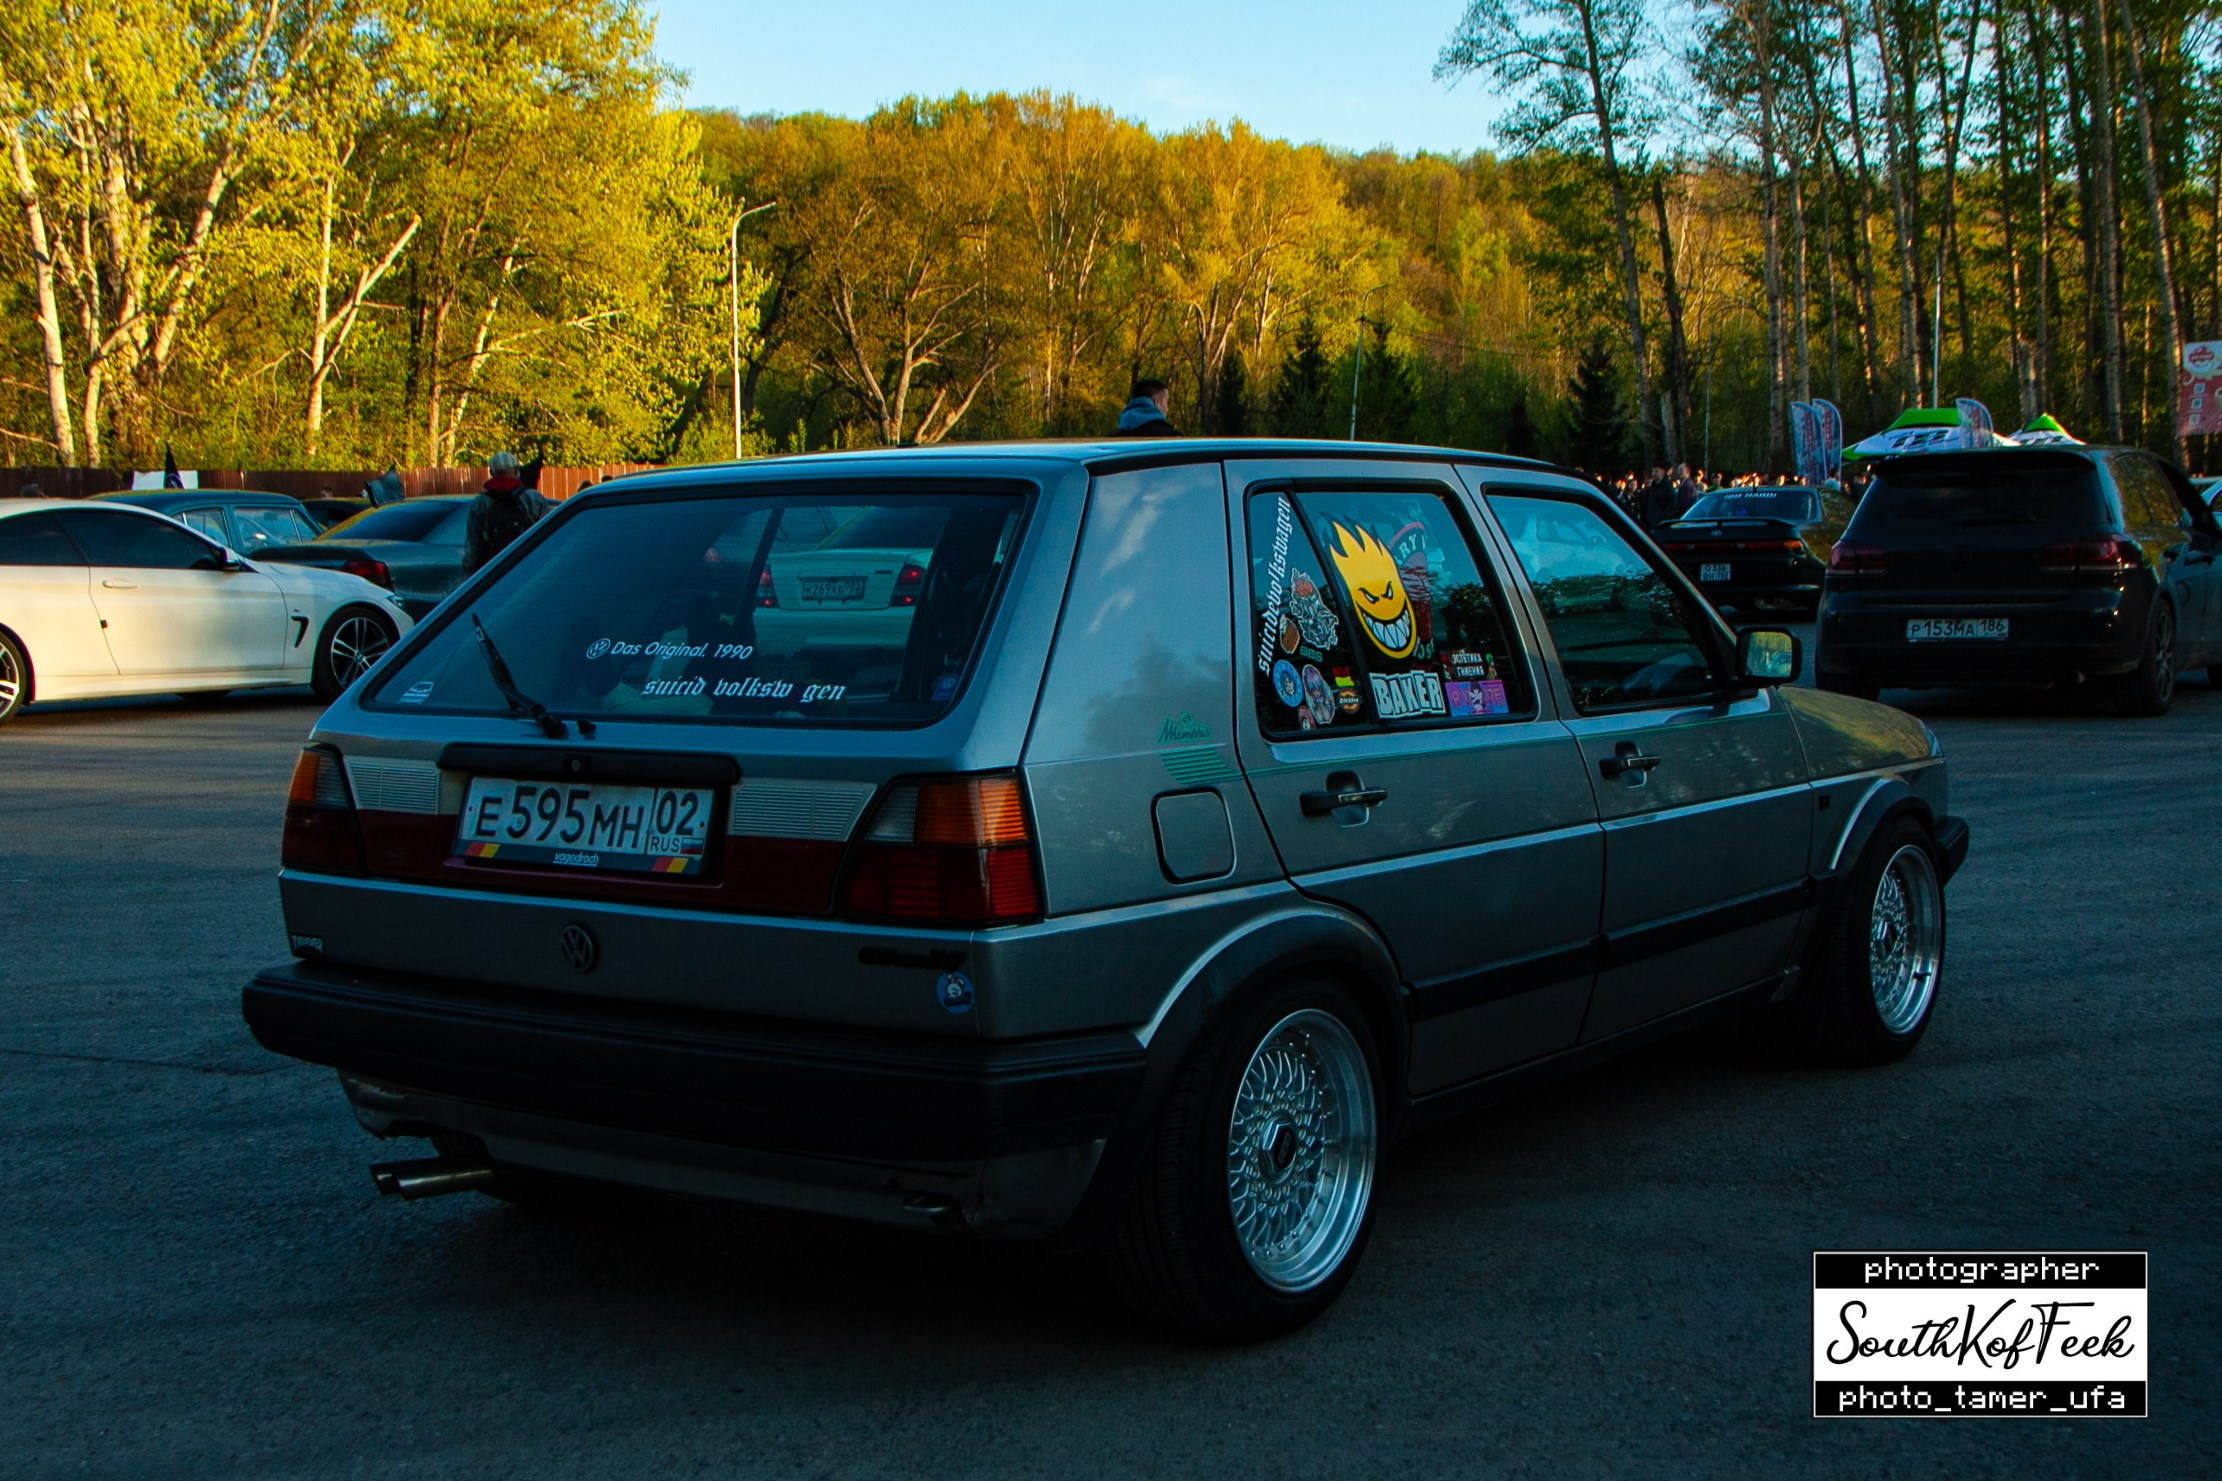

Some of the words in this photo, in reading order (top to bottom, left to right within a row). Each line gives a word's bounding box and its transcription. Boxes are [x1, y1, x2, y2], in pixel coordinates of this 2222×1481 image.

[1911, 620, 1975, 636] Р153МА
[1980, 619, 2005, 632] 186
[610, 641, 640, 655] Das
[644, 641, 707, 659] Original.
[713, 643, 754, 660] 1990
[1300, 645, 1323, 663] BBS
[642, 675, 708, 696] suicid
[712, 676, 794, 698] volksw
[799, 683, 849, 703] gen
[1371, 672, 1444, 716] BAKER
[1157, 718, 1211, 743] Memphis
[474, 785, 645, 849] Е595МН
[656, 790, 700, 836] 02
[650, 837, 681, 853] RUS
